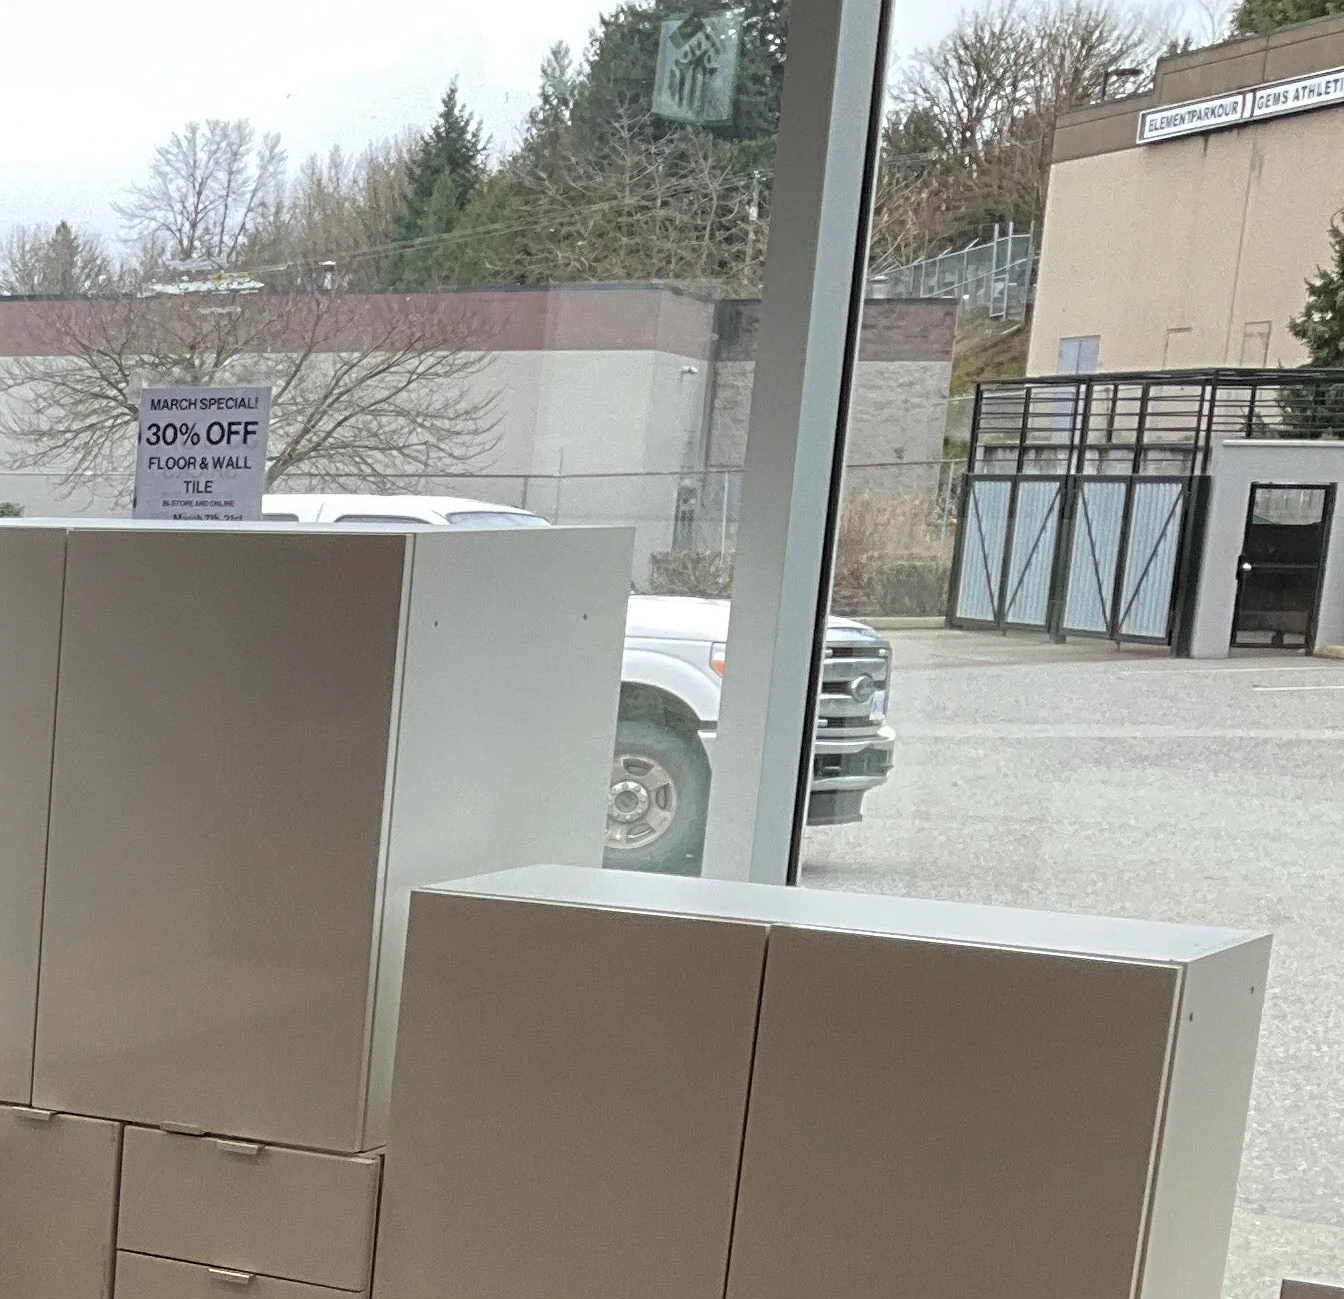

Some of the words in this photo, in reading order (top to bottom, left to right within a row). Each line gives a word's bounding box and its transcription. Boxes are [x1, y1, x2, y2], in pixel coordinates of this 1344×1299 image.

[1256, 91, 1288, 110] GEMS
[150, 398, 198, 411] MARCH
[200, 396, 259, 410] SPECIAL!
[145, 422, 201, 446] 30%
[206, 420, 259, 445] OFF
[148, 457, 197, 470] FLOOR
[199, 457, 208, 470] &
[213, 456, 252, 470] WALL
[183, 481, 214, 494] TILE
